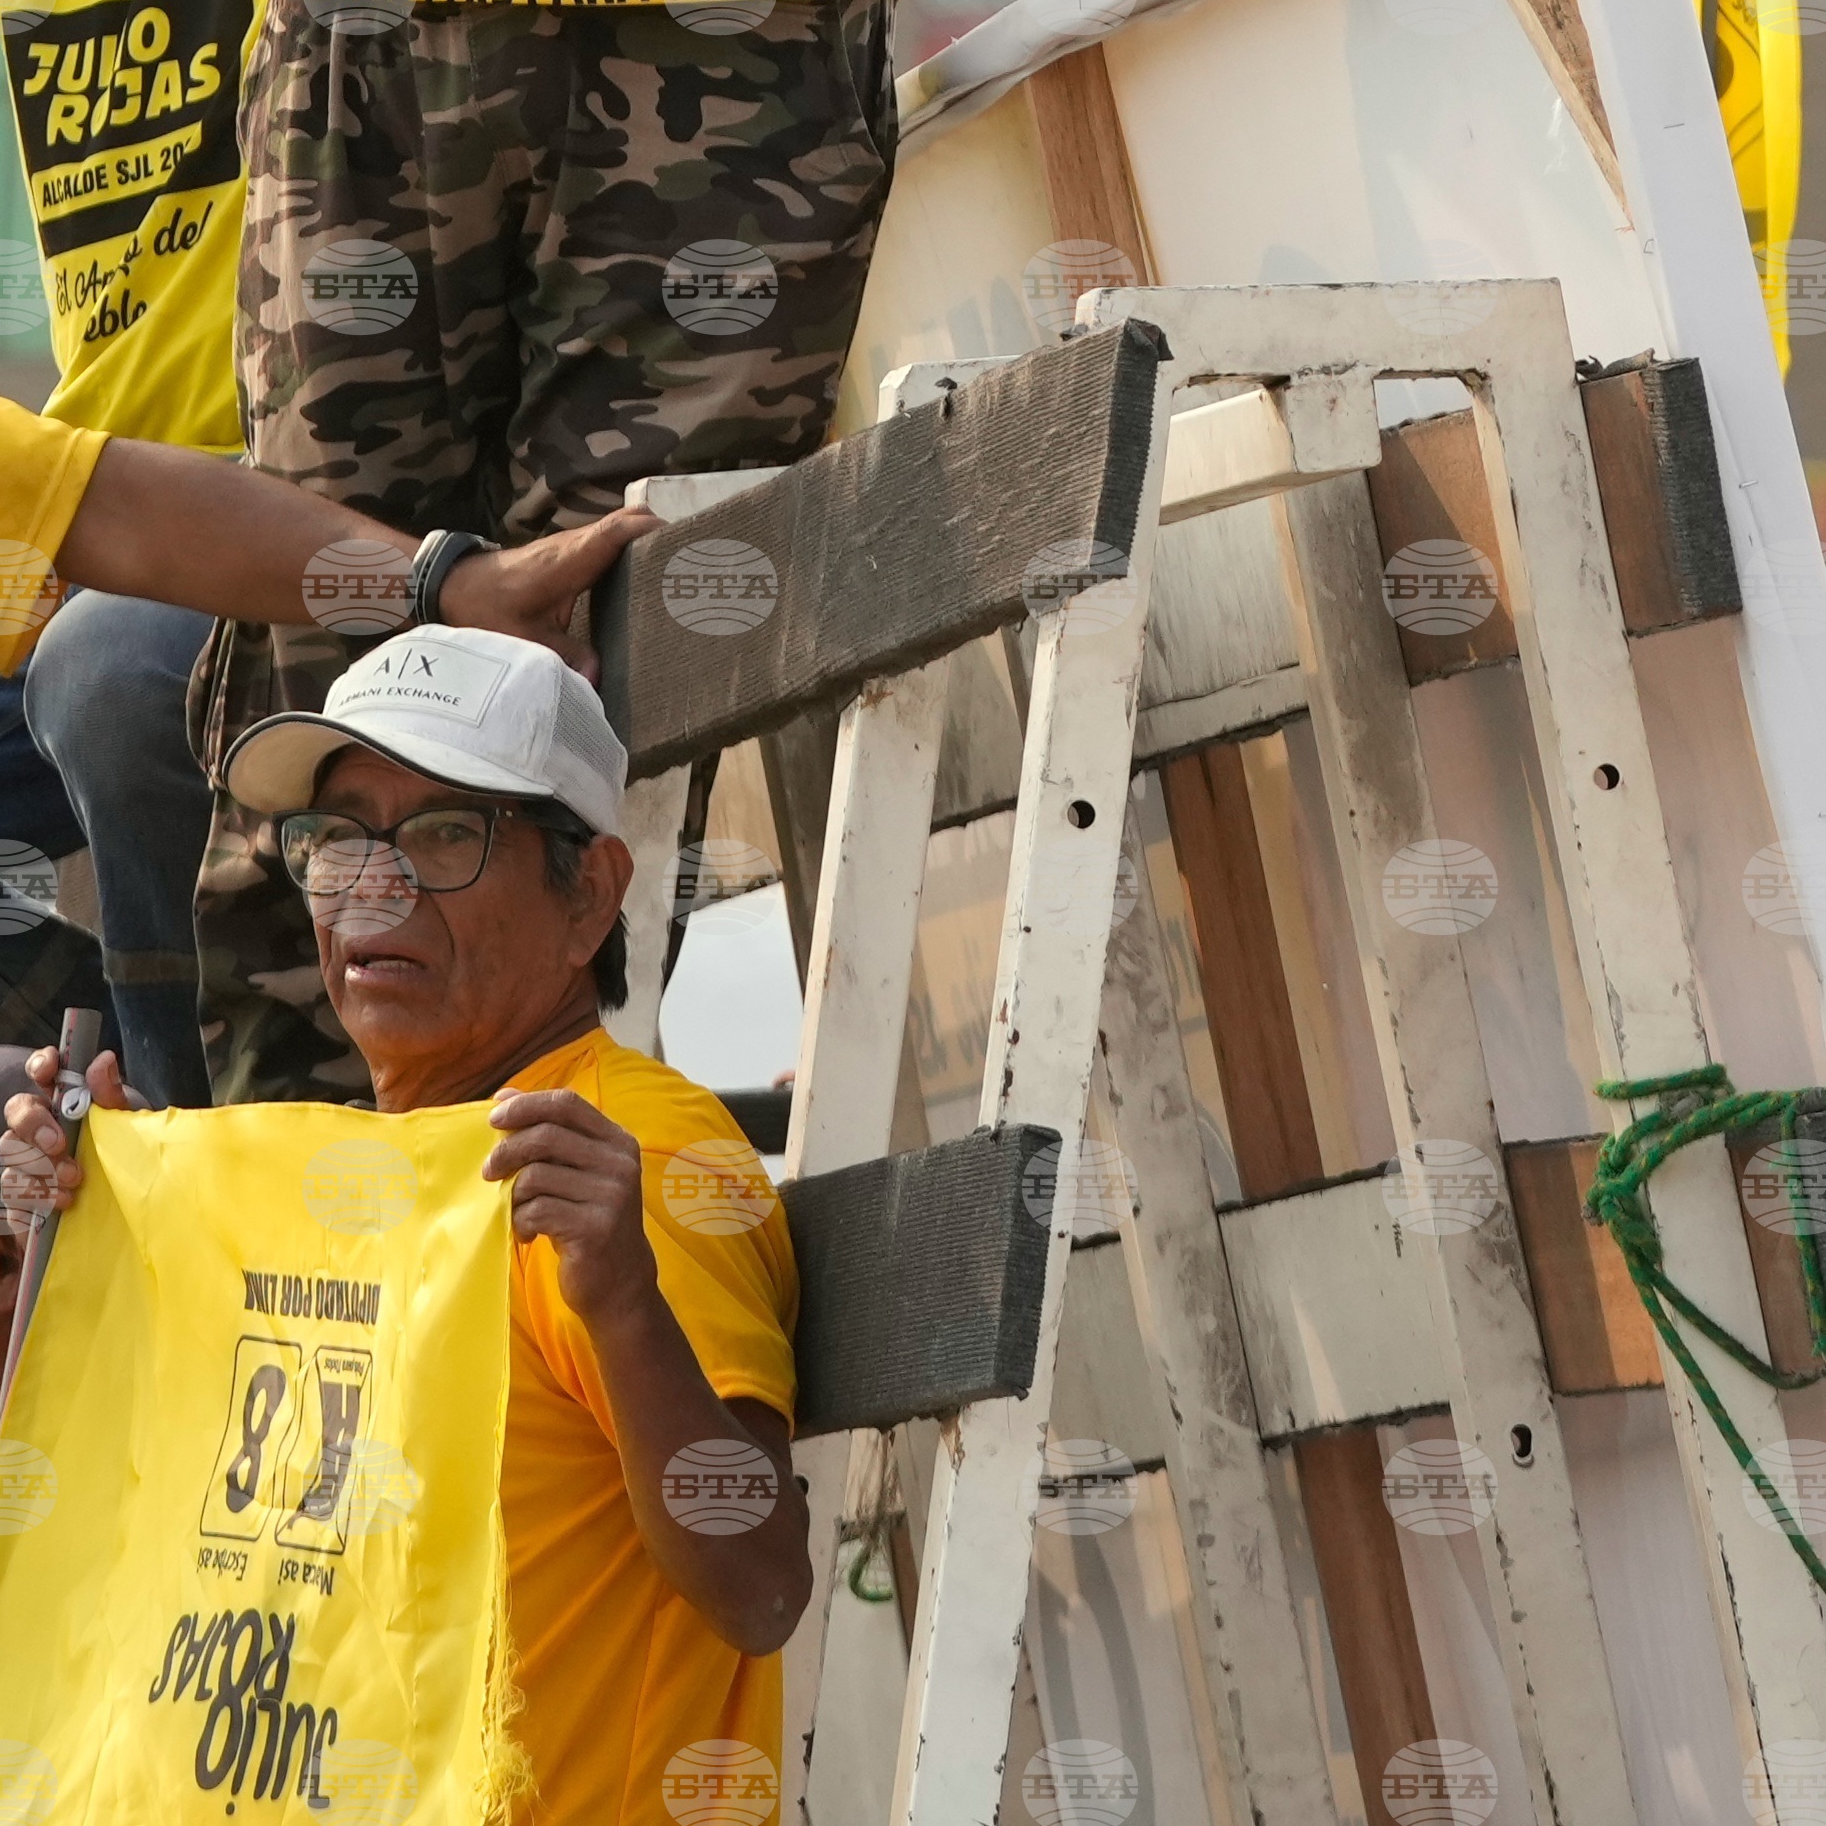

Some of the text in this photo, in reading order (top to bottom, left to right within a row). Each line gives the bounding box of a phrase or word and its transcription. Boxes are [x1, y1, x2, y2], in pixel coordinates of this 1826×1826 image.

[42, 164, 110, 208] ALCALDE
[115, 155, 154, 186] SJL
[153, 200, 214, 255] del
[337, 686, 463, 708] ARMANI EXCHANGE
[279, 1273, 312, 1320] POR
[315, 1277, 381, 1327] DIPUTADO
[225, 1364, 287, 1514] 8
